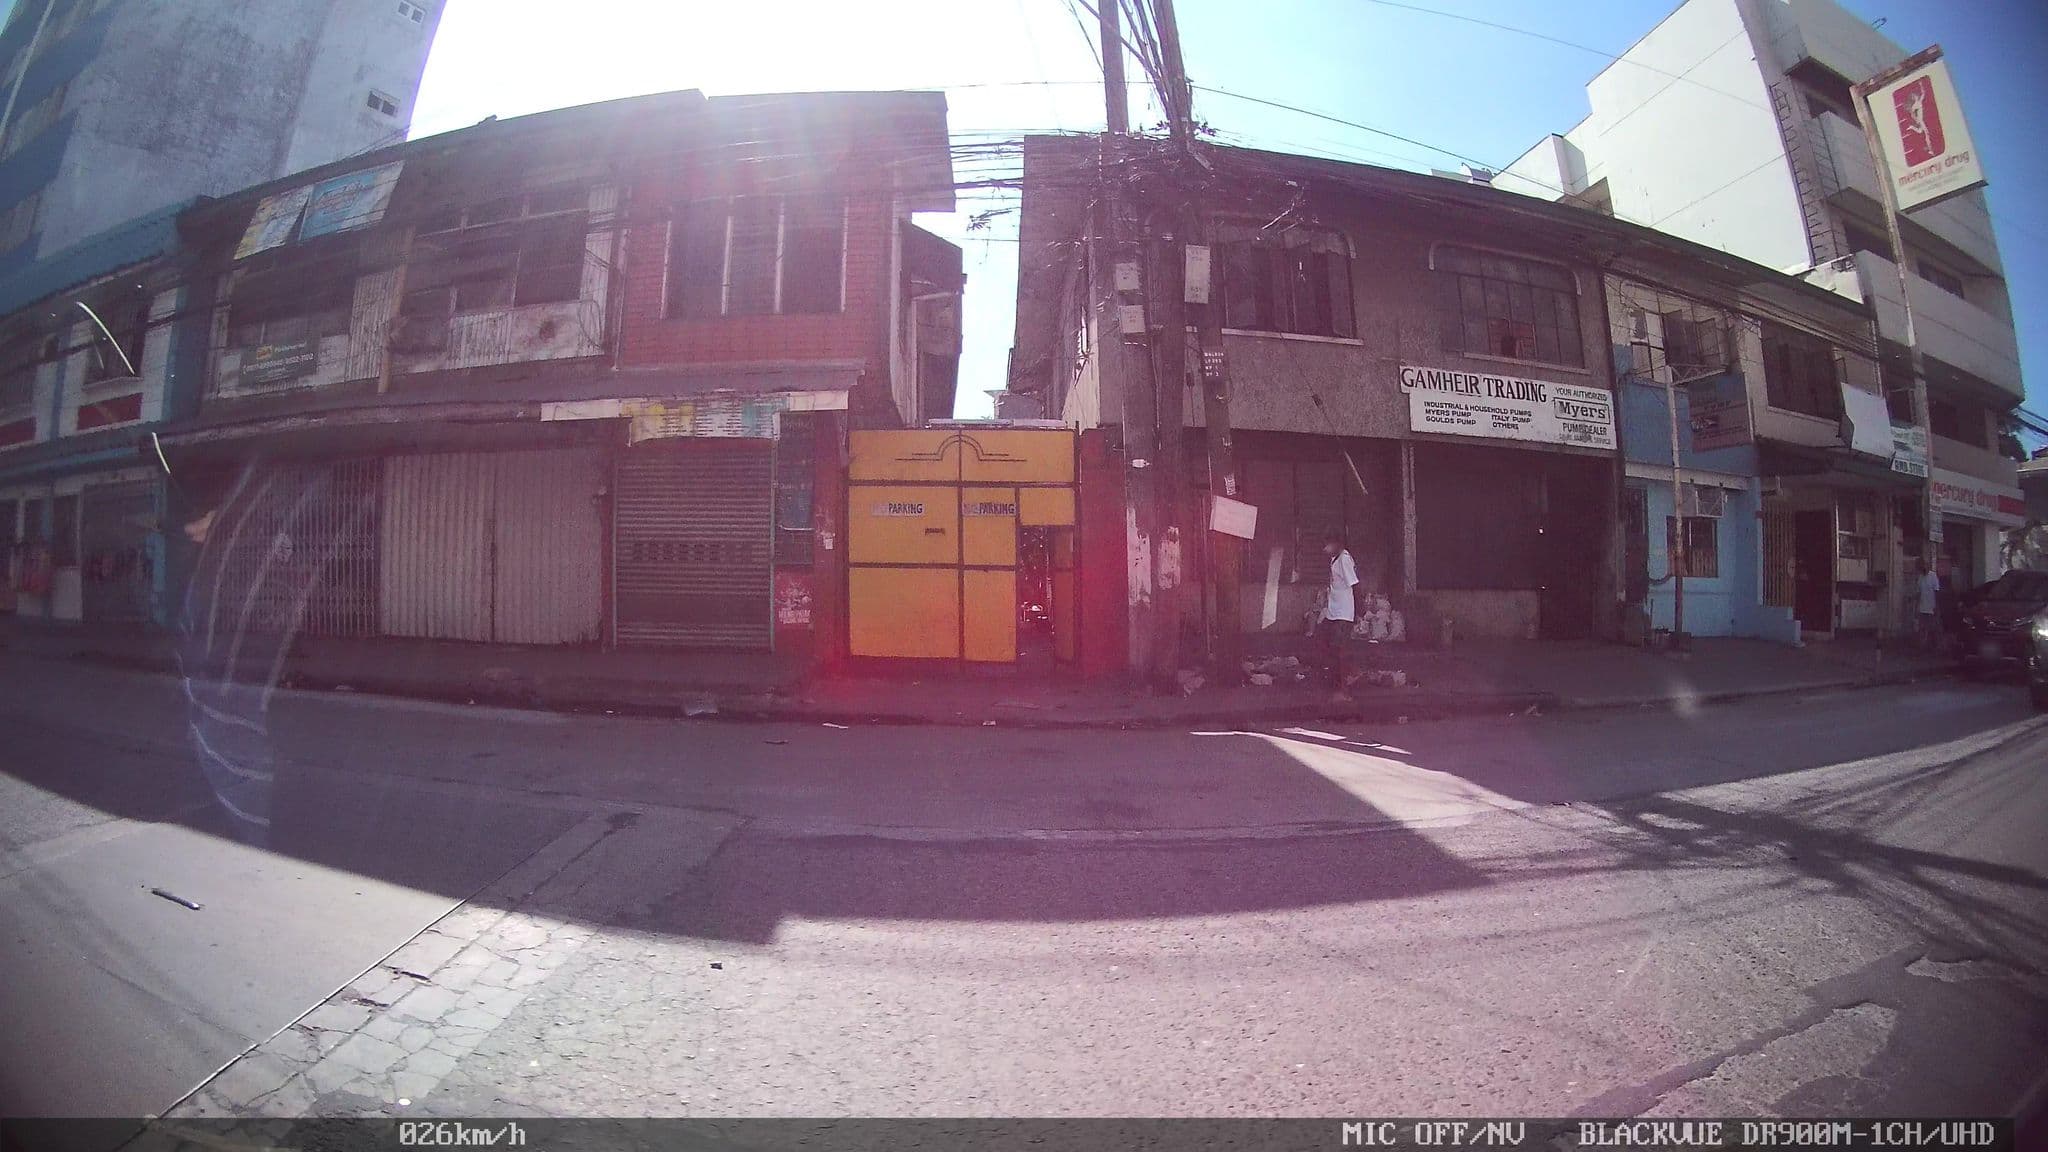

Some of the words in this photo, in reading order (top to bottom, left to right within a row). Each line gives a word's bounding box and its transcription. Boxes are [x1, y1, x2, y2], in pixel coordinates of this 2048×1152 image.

[1898, 162, 1942, 185] mercury
[1945, 151, 1970, 167] drug
[1401, 368, 1480, 395] GAMHEIR
[1482, 377, 1547, 402] TRADING
[1555, 387, 1572, 396] YOUR
[1573, 390, 1607, 401] AUTHORIZED
[1424, 401, 1464, 410] INDUSTRIAL
[1469, 404, 1509, 415] HOUSEHOLD
[1510, 408, 1532, 417] PUMPS
[1425, 409, 1450, 417] MYERS
[1558, 400, 1606, 419] Myers
[1425, 416, 1454, 424] GOULDS
[1491, 414, 1510, 422] ITALY
[1512, 416, 1531, 424] PUMP
[1492, 422, 1519, 430] OTHERS
[888, 503, 923, 514] PARKING
[979, 503, 1015, 514] PARKING
